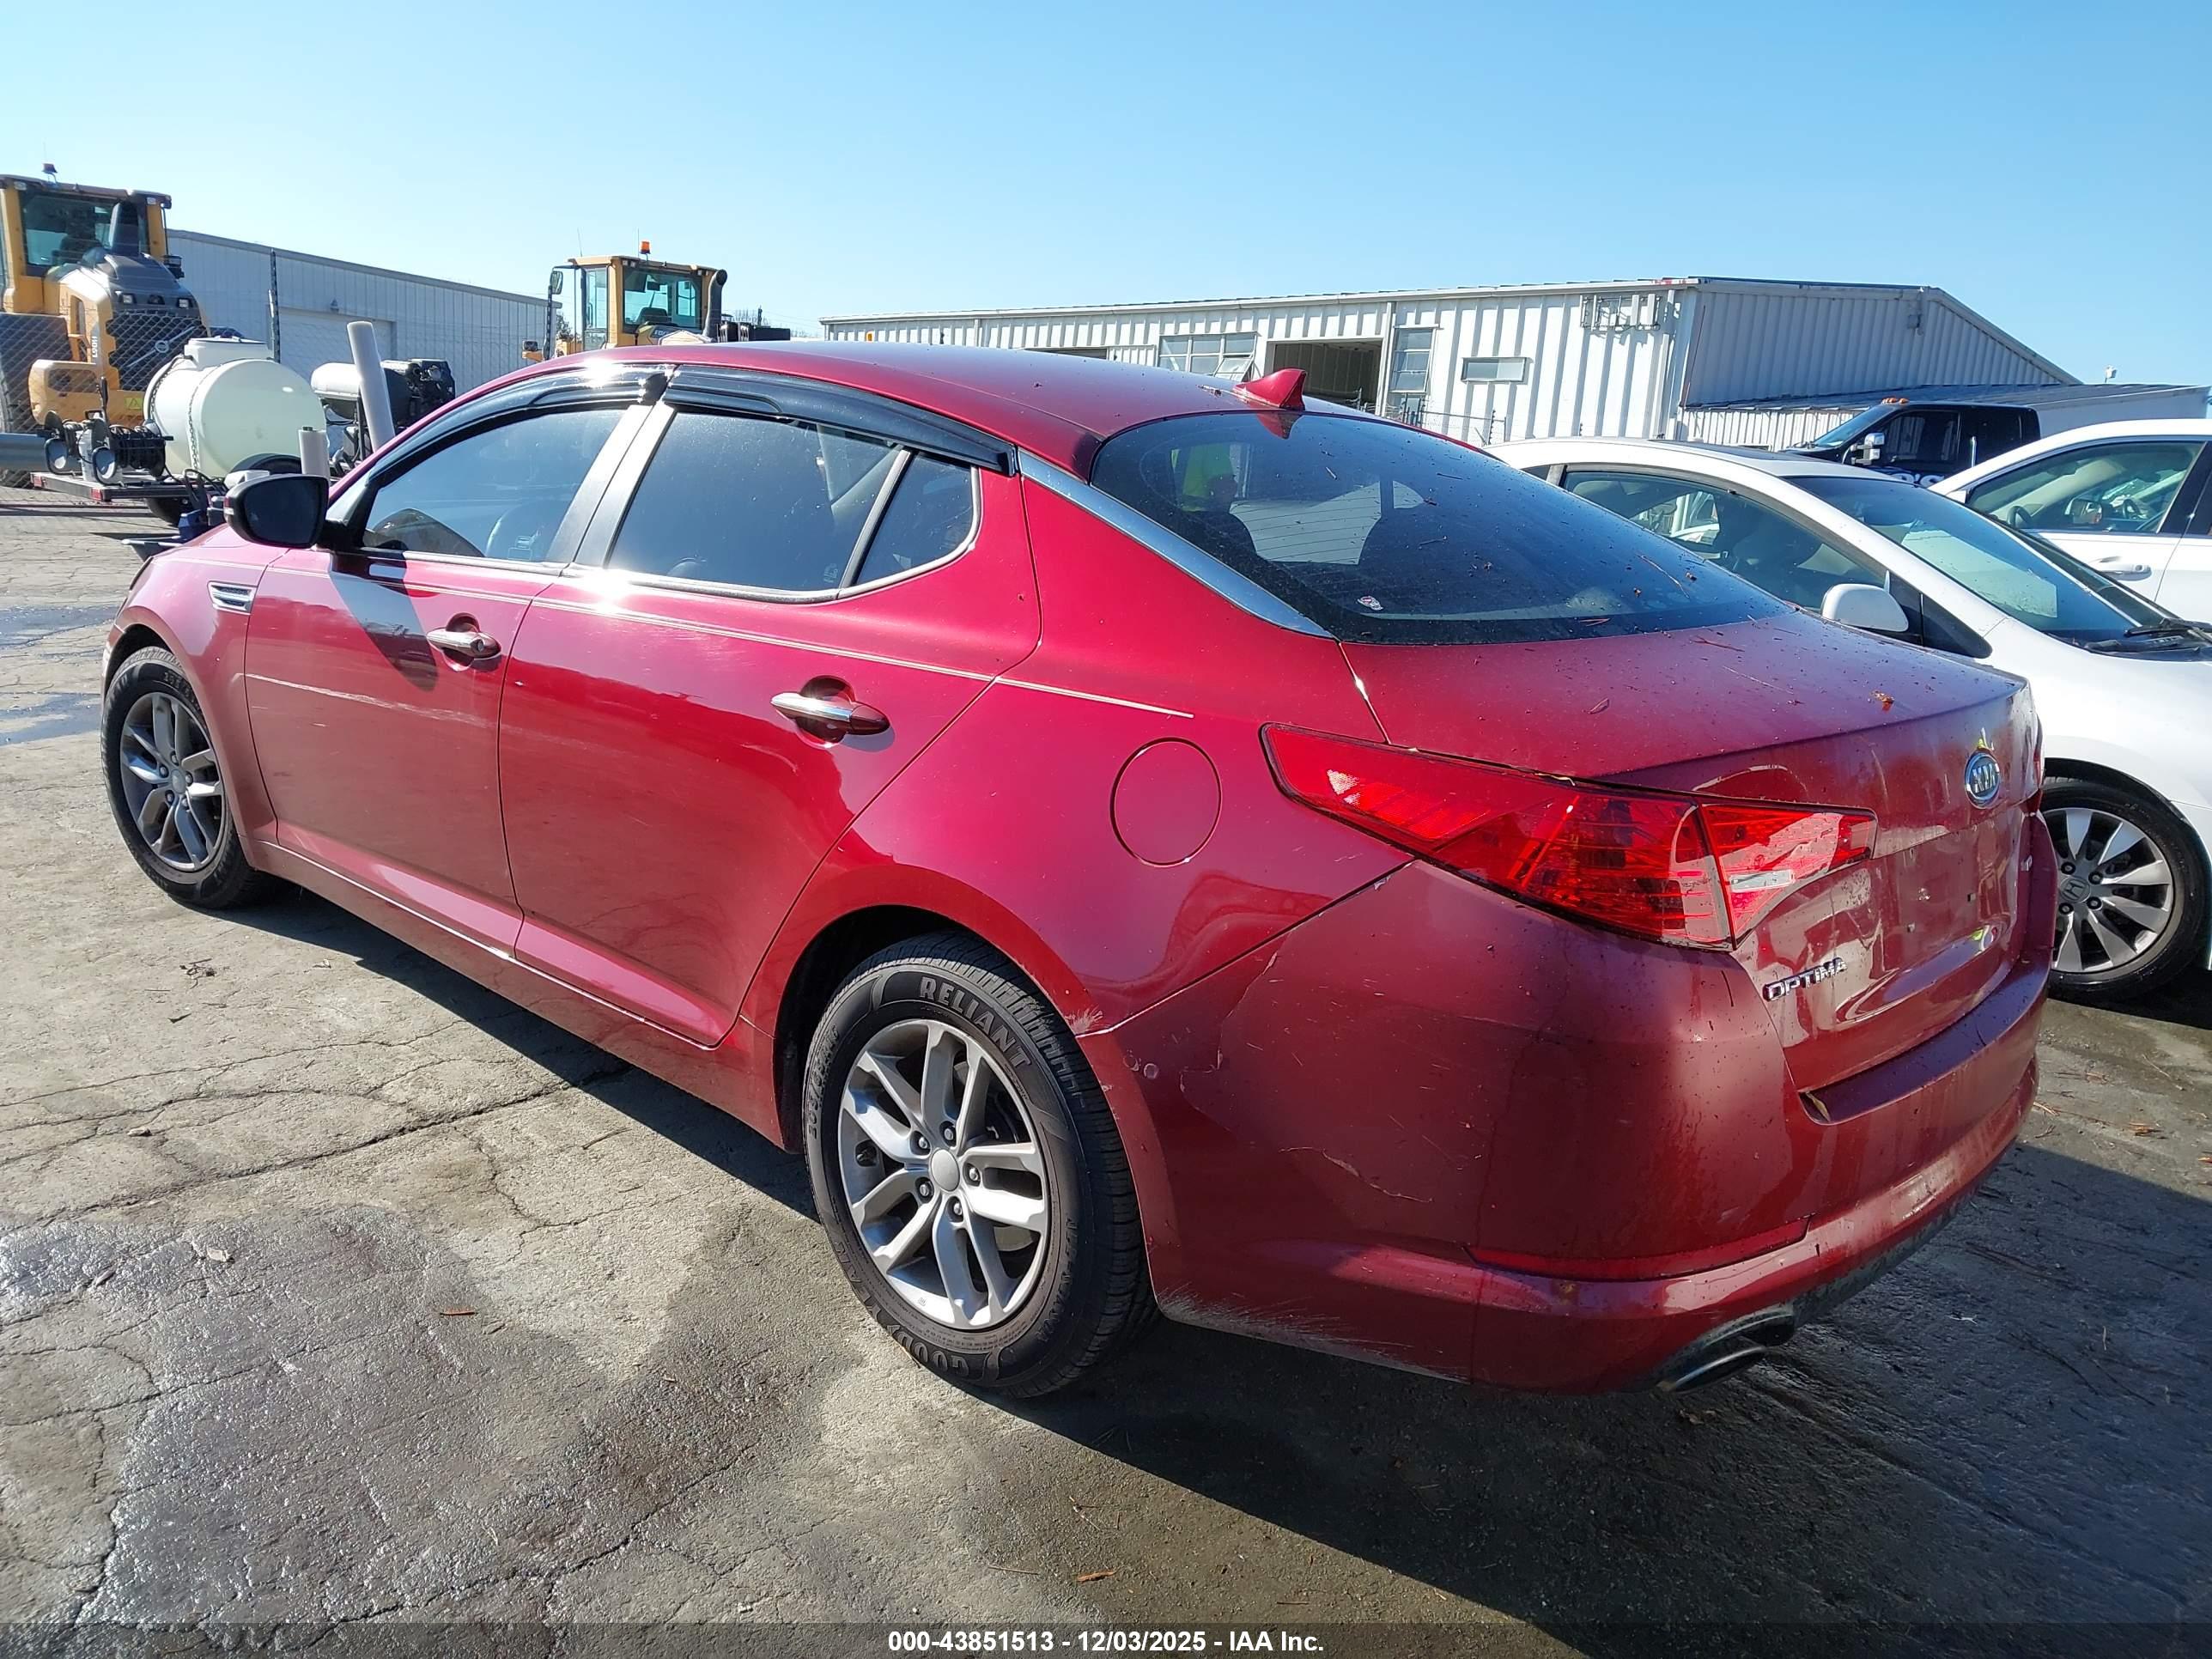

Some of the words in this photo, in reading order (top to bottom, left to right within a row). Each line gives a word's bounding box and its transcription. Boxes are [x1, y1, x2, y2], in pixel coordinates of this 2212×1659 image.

[918, 975, 1034, 1067] RELIANT
[1763, 957, 1848, 1001] OPTIMA
[832, 1241, 970, 1377] GOODYEAR
